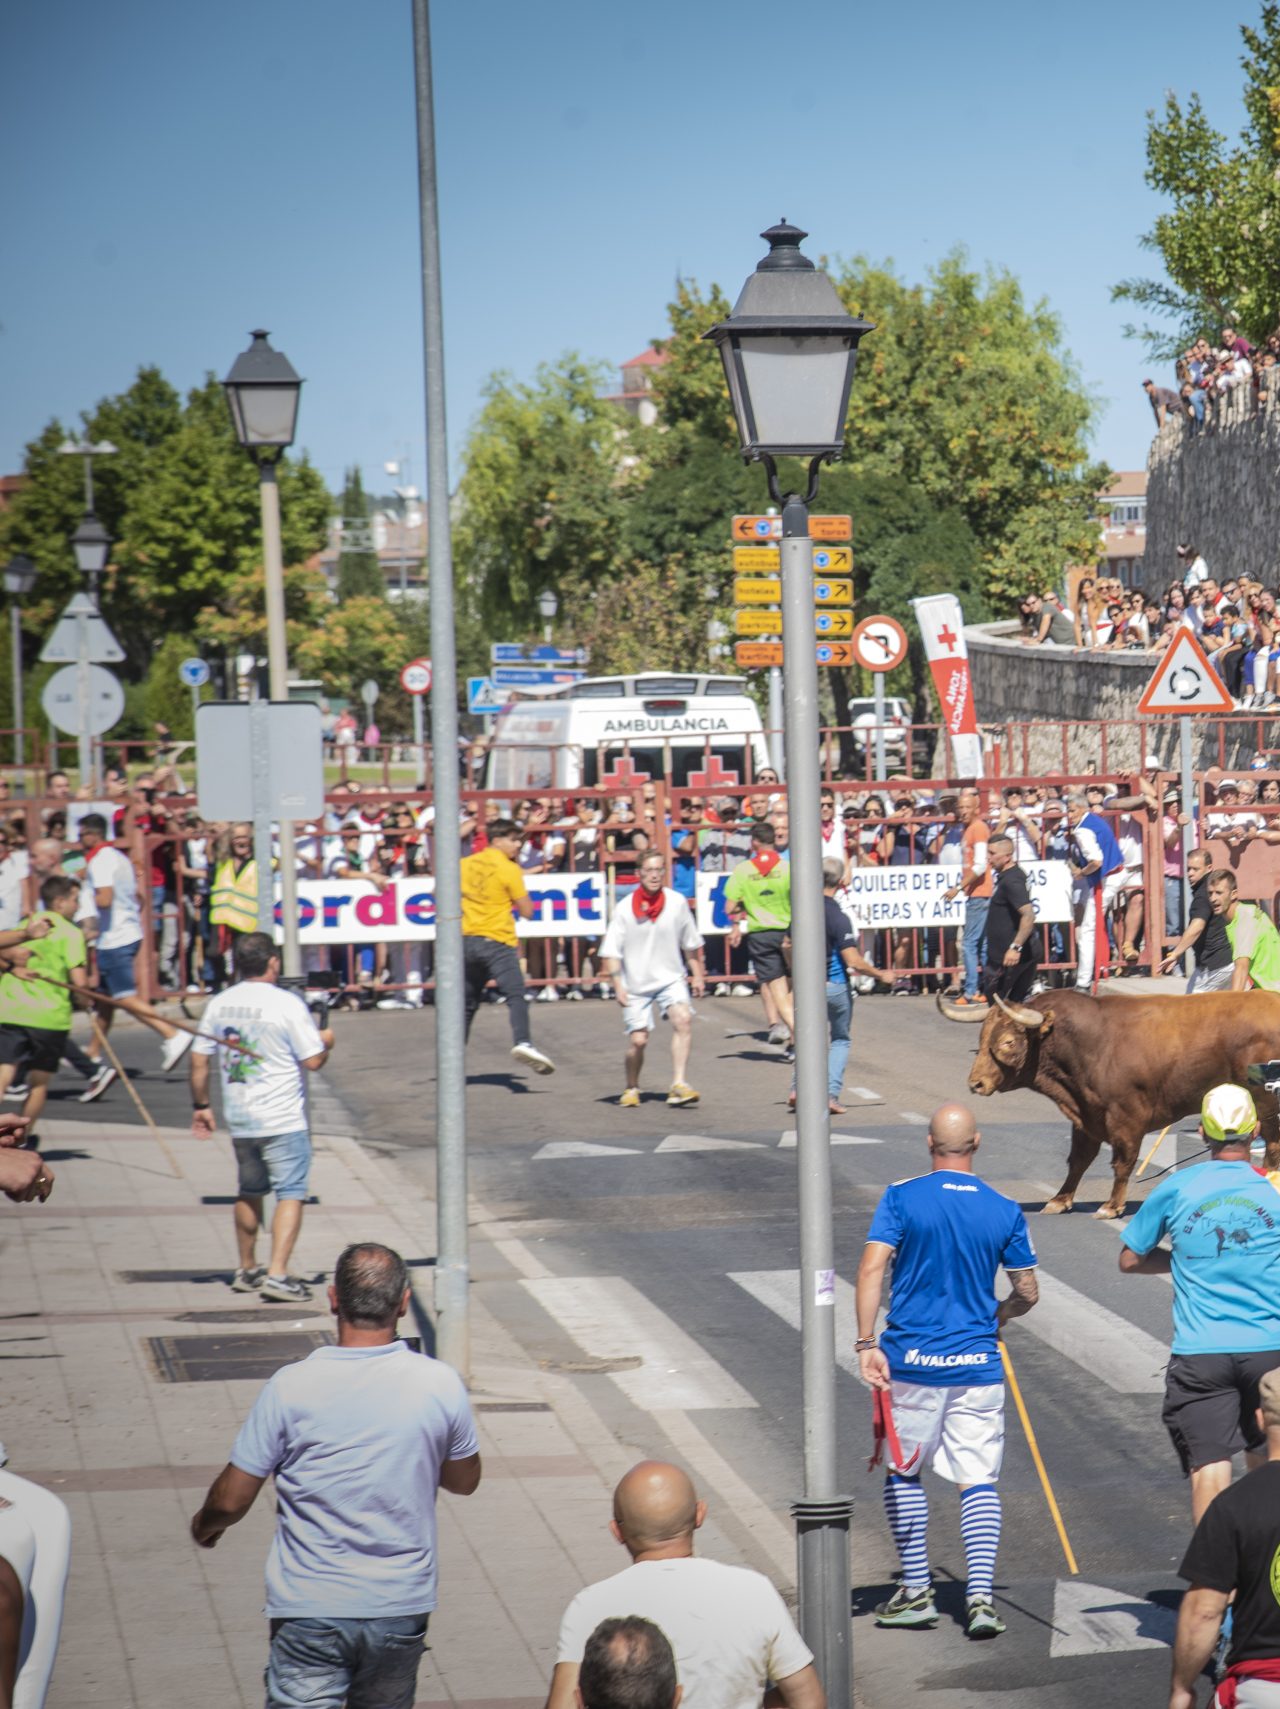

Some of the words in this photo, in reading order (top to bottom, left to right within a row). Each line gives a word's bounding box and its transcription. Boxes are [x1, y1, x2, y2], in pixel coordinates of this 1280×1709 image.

[604, 717, 729, 732] AMBULANCIA
[912, 873, 932, 890] DE
[916, 901, 928, 919] Y
[919, 1353, 989, 1367] VALCARCE
